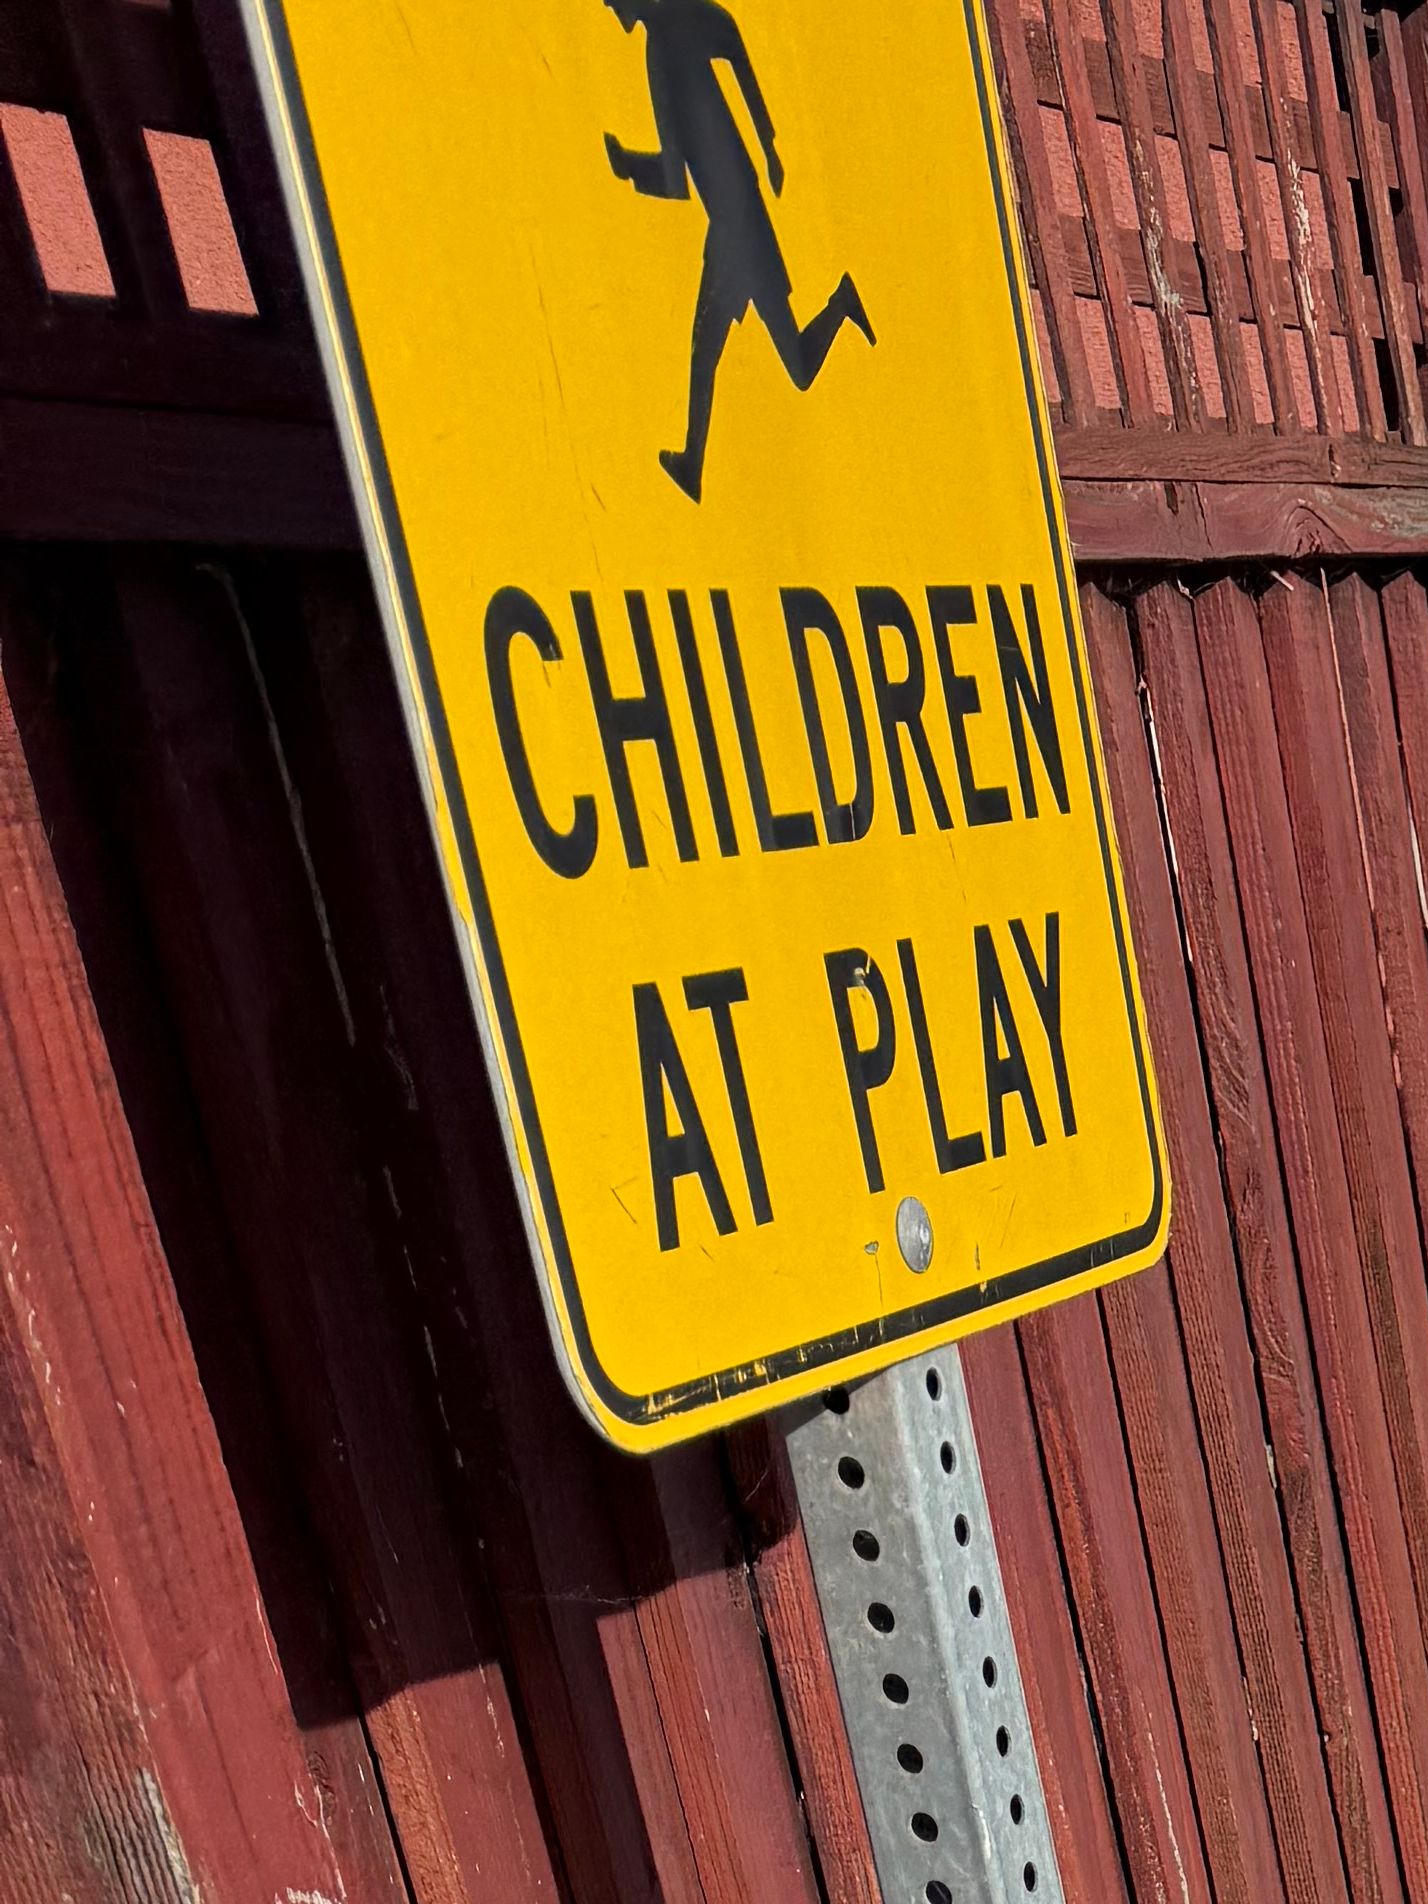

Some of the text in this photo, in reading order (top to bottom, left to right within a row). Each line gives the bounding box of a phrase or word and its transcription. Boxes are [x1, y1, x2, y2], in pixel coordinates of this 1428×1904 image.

[484, 585, 1070, 879] CHILDREN
[633, 913, 1077, 1251] AT PLAY
